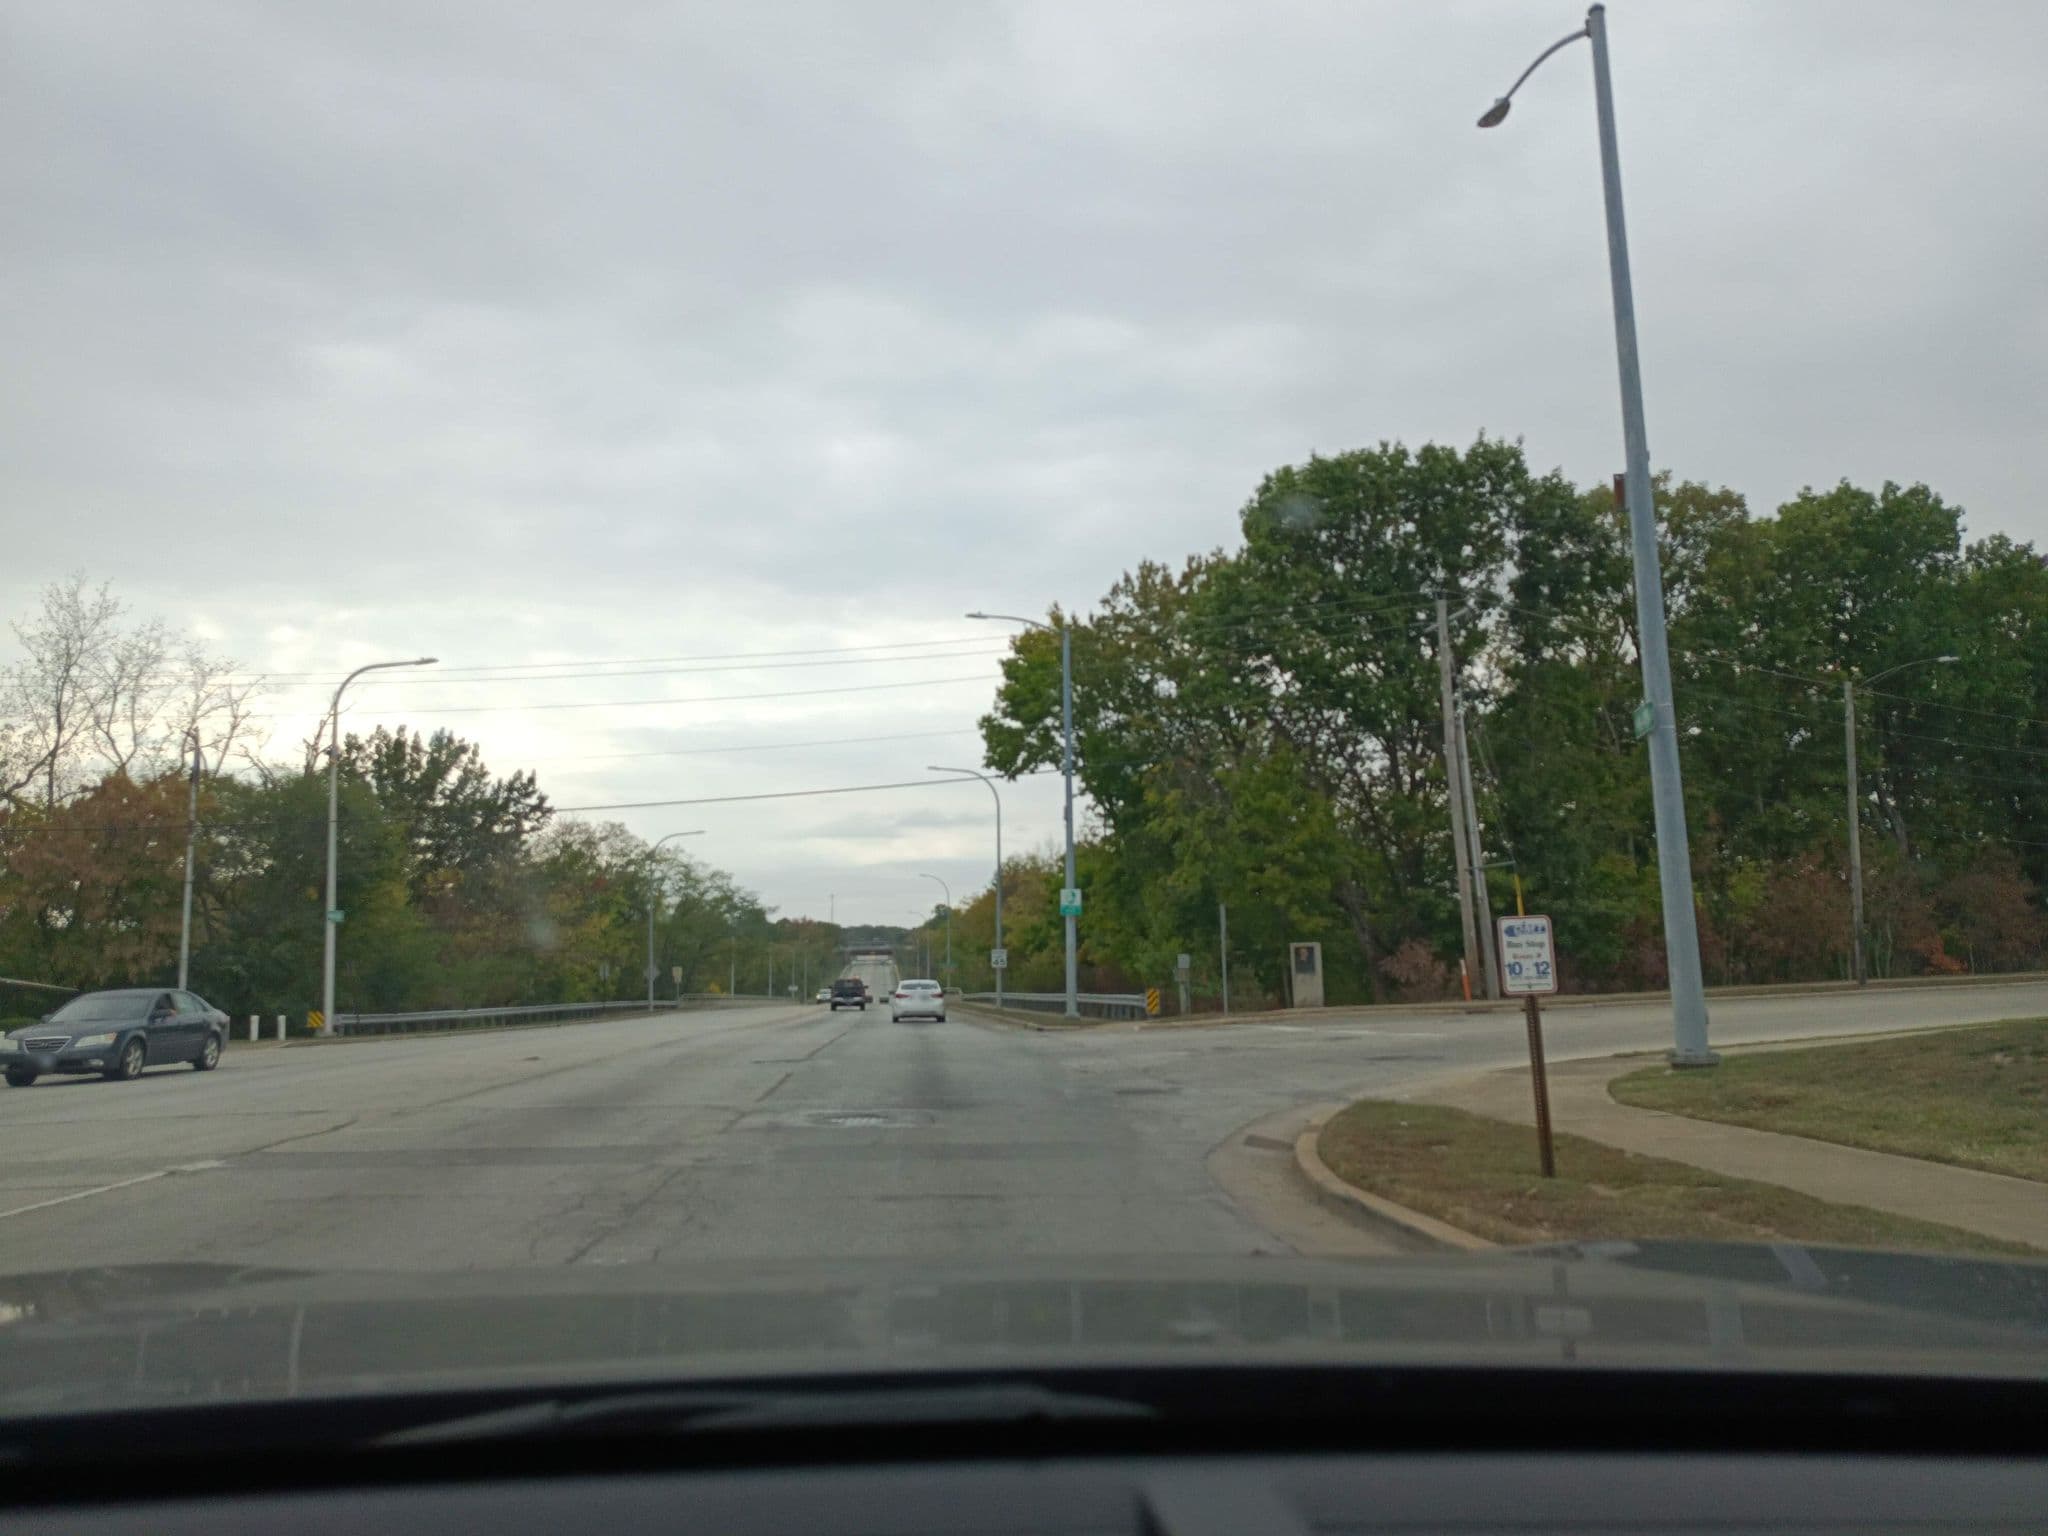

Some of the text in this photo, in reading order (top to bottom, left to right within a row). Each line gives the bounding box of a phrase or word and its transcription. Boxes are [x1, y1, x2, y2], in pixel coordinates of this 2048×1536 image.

[1507, 941, 1545, 950] Bus Stop
[1506, 962, 1523, 976] 10
[1534, 961, 1550, 975] 12
